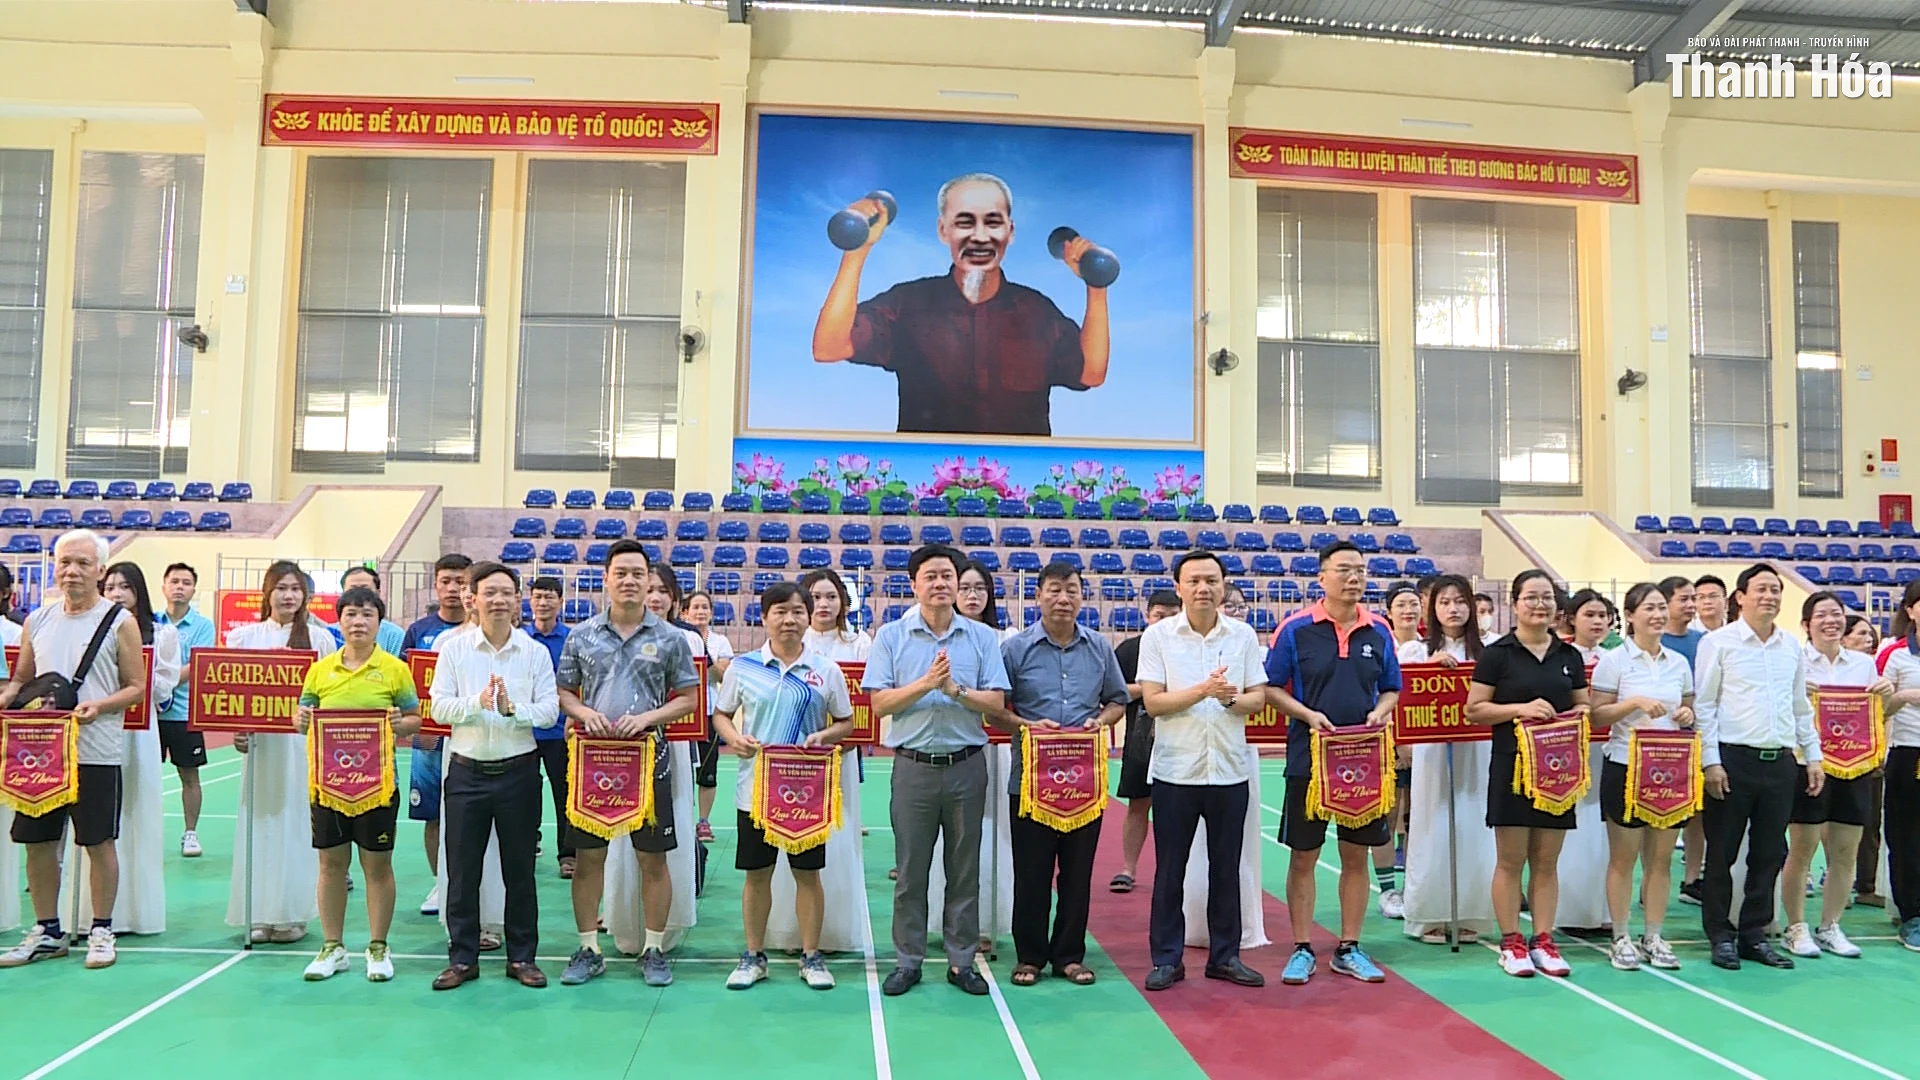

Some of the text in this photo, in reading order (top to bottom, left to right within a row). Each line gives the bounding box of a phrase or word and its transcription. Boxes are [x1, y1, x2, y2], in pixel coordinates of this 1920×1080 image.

[317, 107, 664, 140] KHỎE ĐỂ XÂY DỰNG VÀ BẢO VỆ TỔ QUỐC!
[1279, 144, 1309, 166] TOÀN
[1311, 145, 1334, 168] DÂN
[1361, 150, 1396, 175] LUYỆN
[1397, 152, 1426, 174] THÂN
[1428, 151, 1448, 175] THỂ
[1450, 158, 1476, 177] THEO
[1479, 159, 1515, 181] GƯƠNG
[1517, 160, 1538, 182] BÁC
[1569, 166, 1591, 188] ĐẠI!
[203, 662, 304, 687] AGRIBANK
[1411, 674, 1457, 694] ĐƠN
[201, 689, 245, 716] YÊN
[1404, 698, 1438, 729] THUẾ
[1441, 702, 1460, 727] CƠ
